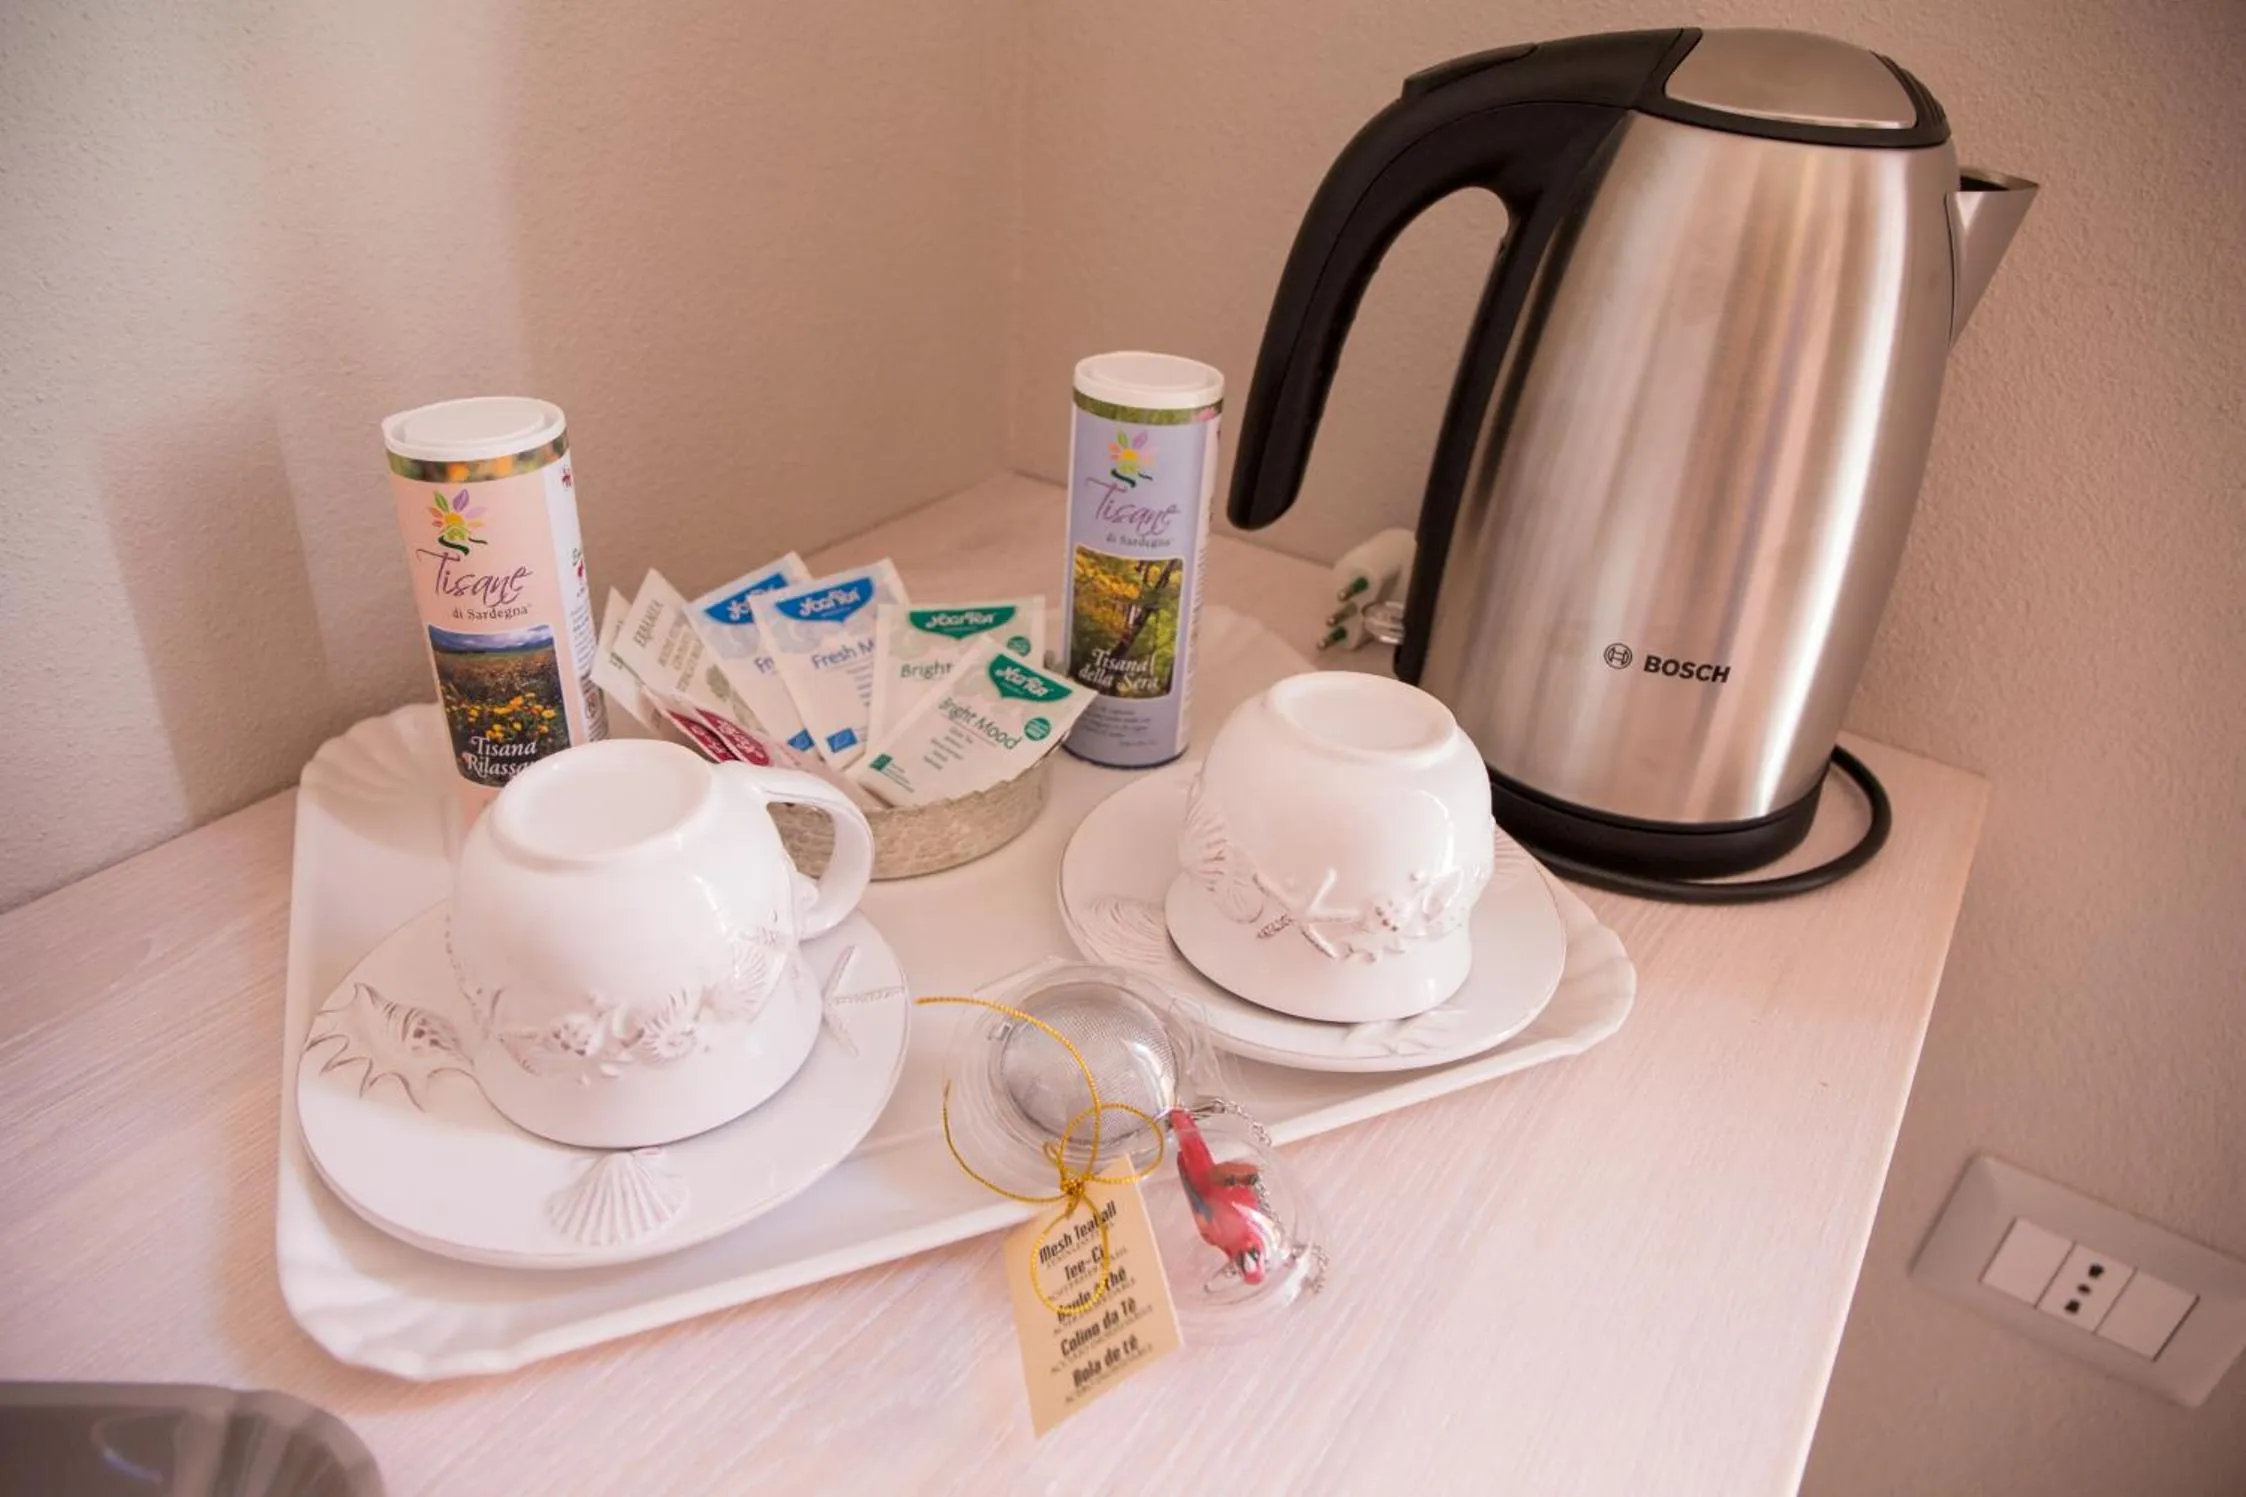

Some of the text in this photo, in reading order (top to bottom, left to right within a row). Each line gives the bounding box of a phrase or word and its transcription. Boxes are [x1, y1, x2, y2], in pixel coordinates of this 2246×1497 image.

[1085, 477, 1180, 536] Tisane
[415, 548, 534, 608] Tisane
[452, 605, 530, 621] di Sardegna
[811, 639, 875, 669] Fresh M
[1091, 646, 1150, 672] Tisana
[1643, 654, 1731, 684] BOSCH
[901, 659, 953, 680] Bright
[1077, 663, 1161, 694] della Sera
[470, 735, 537, 758] Tisana
[974, 714, 1022, 750] Mood
[462, 750, 535, 779] Rilassa
[1039, 1232, 1073, 1265] Mesh
[1102, 1308, 1120, 1330] da
[1072, 1359, 1103, 1388] Bola
[1104, 1347, 1121, 1368] de
